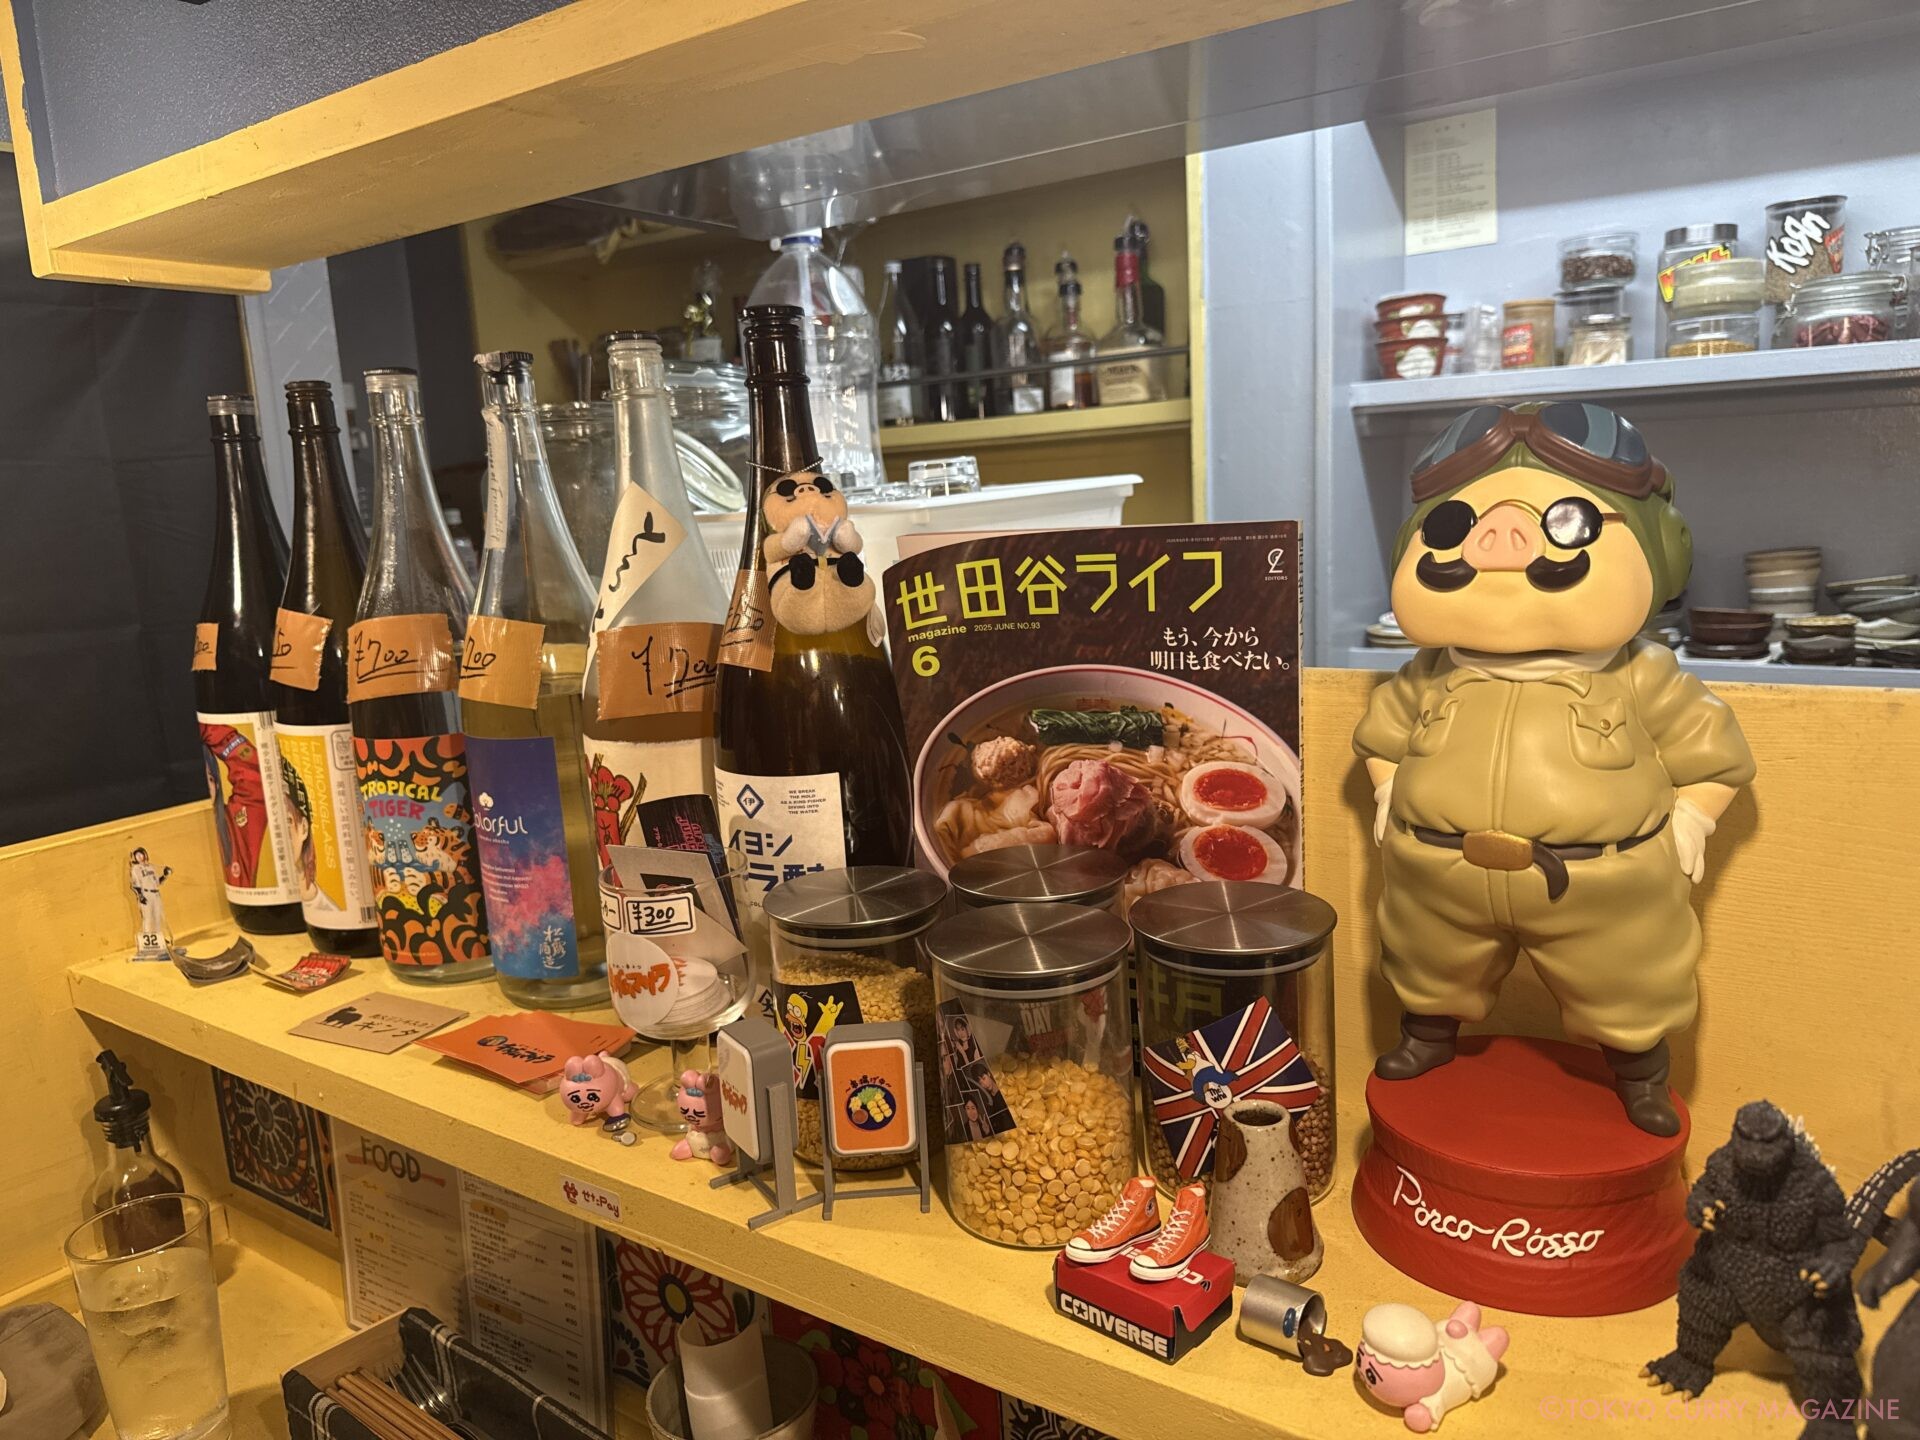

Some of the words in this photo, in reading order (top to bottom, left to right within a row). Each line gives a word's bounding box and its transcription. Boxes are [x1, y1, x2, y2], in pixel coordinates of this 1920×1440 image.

[896, 551, 1223, 630] 世田谷ライフ
[908, 625, 967, 643] magazine
[974, 624, 993, 632] 2025
[994, 623, 1016, 631] JUNE
[1017, 622, 1041, 630] NO.93
[1163, 626, 1260, 648] もう、今から
[912, 645, 941, 677] 6
[1150, 650, 1290, 671] 明日も食べたい。
[360, 780, 444, 802] TROPICAL
[368, 799, 426, 821] TIGER
[632, 901, 675, 931] ¥300
[143, 934, 159, 946] 32
[1021, 1006, 1053, 1037] DAY
[361, 1136, 421, 1183] FOOD
[1393, 1165, 1495, 1241] Porco
[1491, 1218, 1605, 1259] Rosso
[1060, 1292, 1168, 1358] CONVERSE
